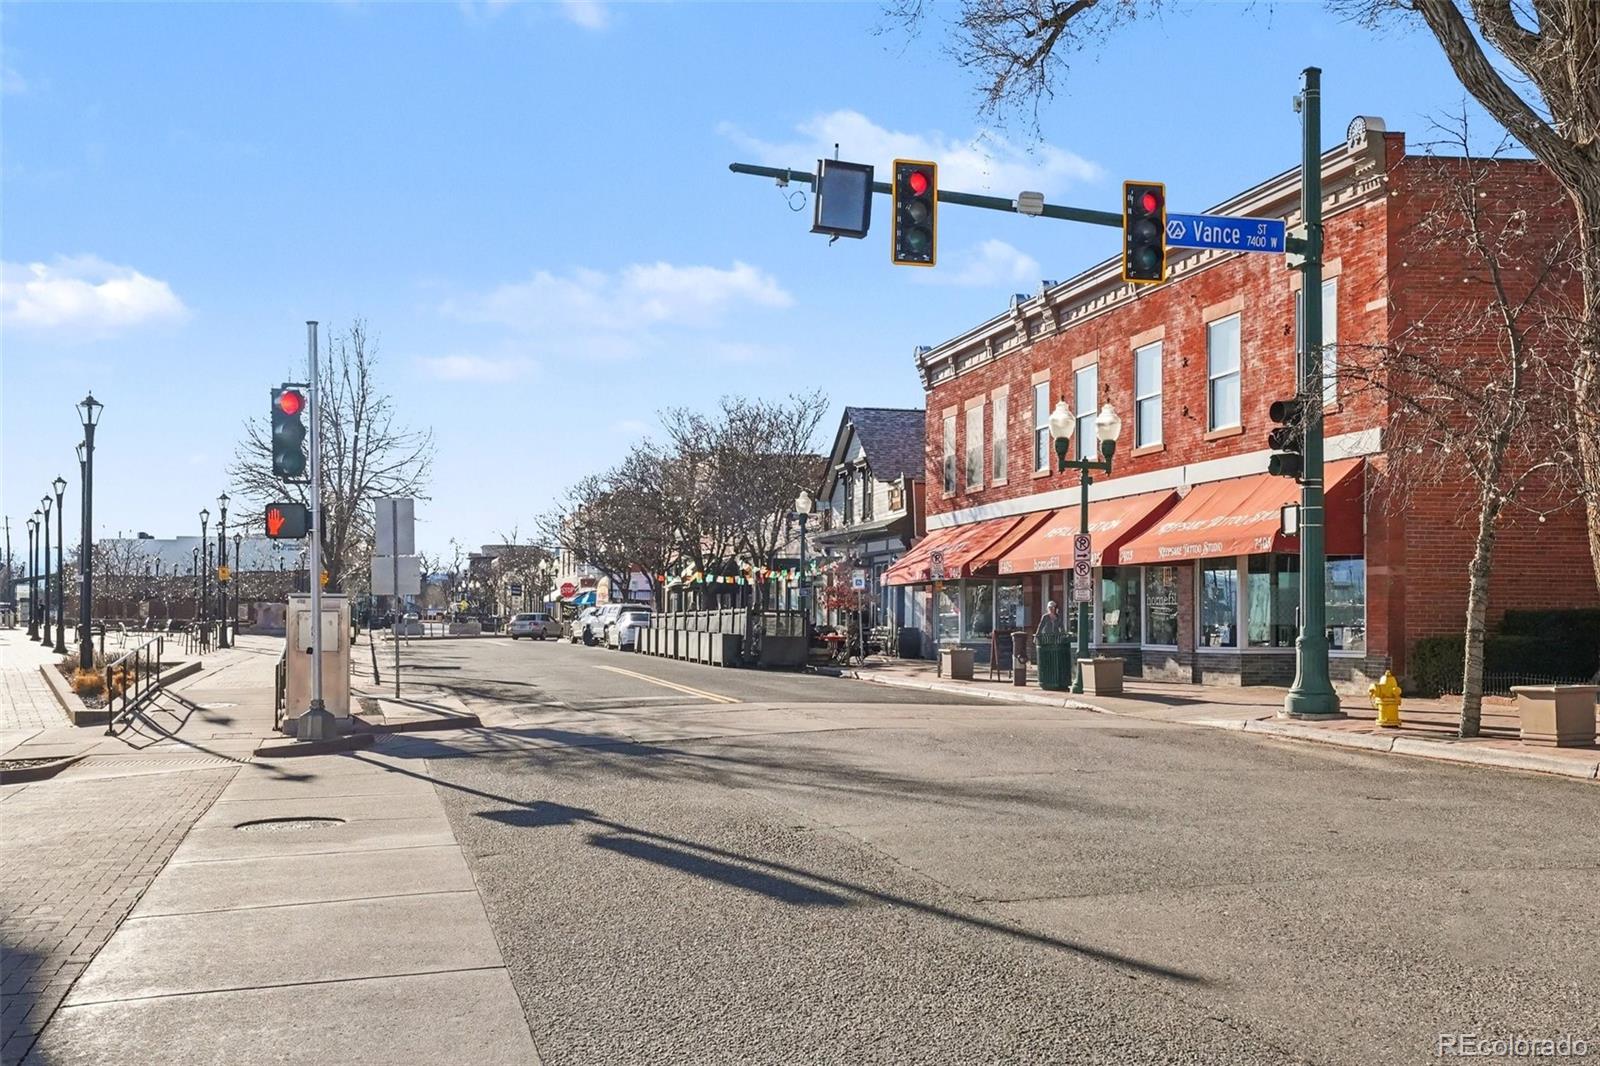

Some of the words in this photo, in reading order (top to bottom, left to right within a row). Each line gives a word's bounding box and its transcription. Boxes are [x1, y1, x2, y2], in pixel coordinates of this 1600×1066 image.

[1193, 220, 1241, 245] Vance
[1257, 223, 1268, 235] ST
[1246, 235, 1267, 248] 7400
[1270, 237, 1278, 249] W
